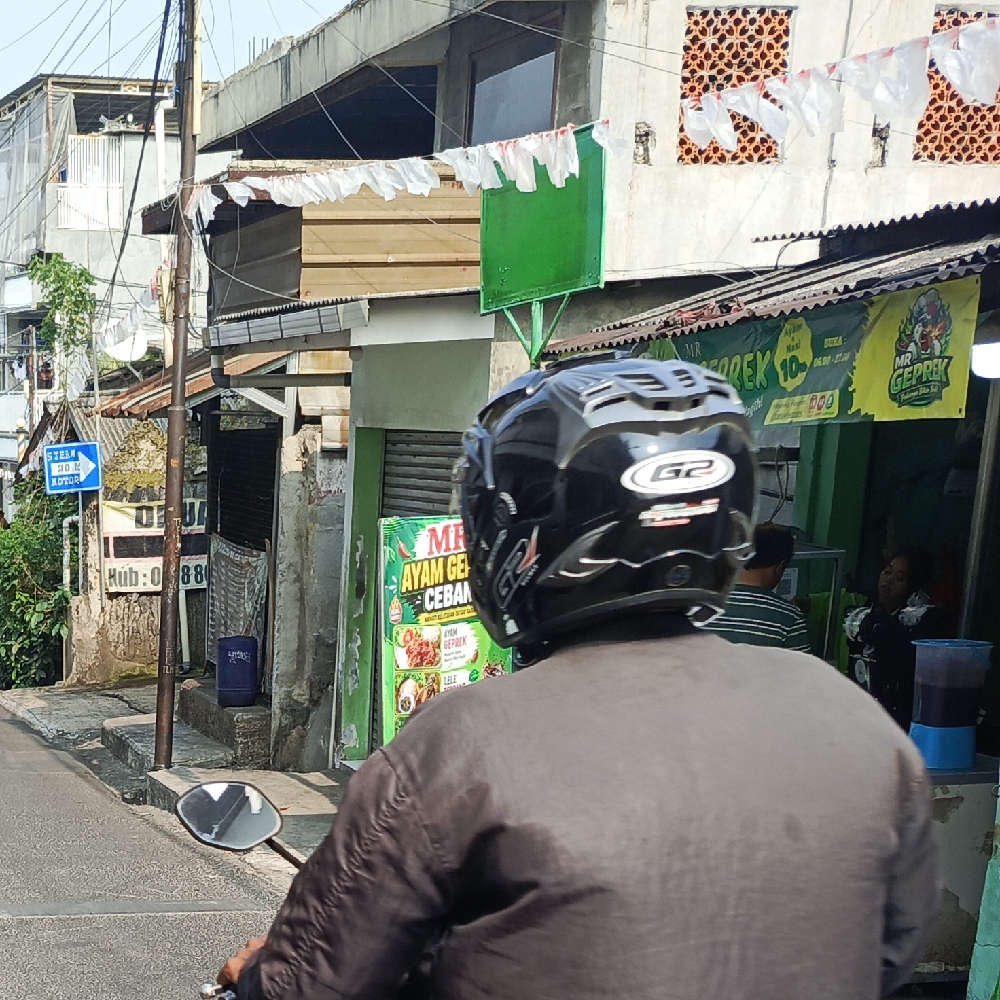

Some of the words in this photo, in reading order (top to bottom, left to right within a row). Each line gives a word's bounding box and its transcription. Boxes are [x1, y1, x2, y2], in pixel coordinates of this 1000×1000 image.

[684, 342, 702, 358] MR
[895, 353, 912, 369] MR
[890, 359, 948, 394] GEPREK
[401, 558, 445, 593] AYAM
[444, 628, 458, 638] AYAM
[443, 636, 467, 651] GEPREK
